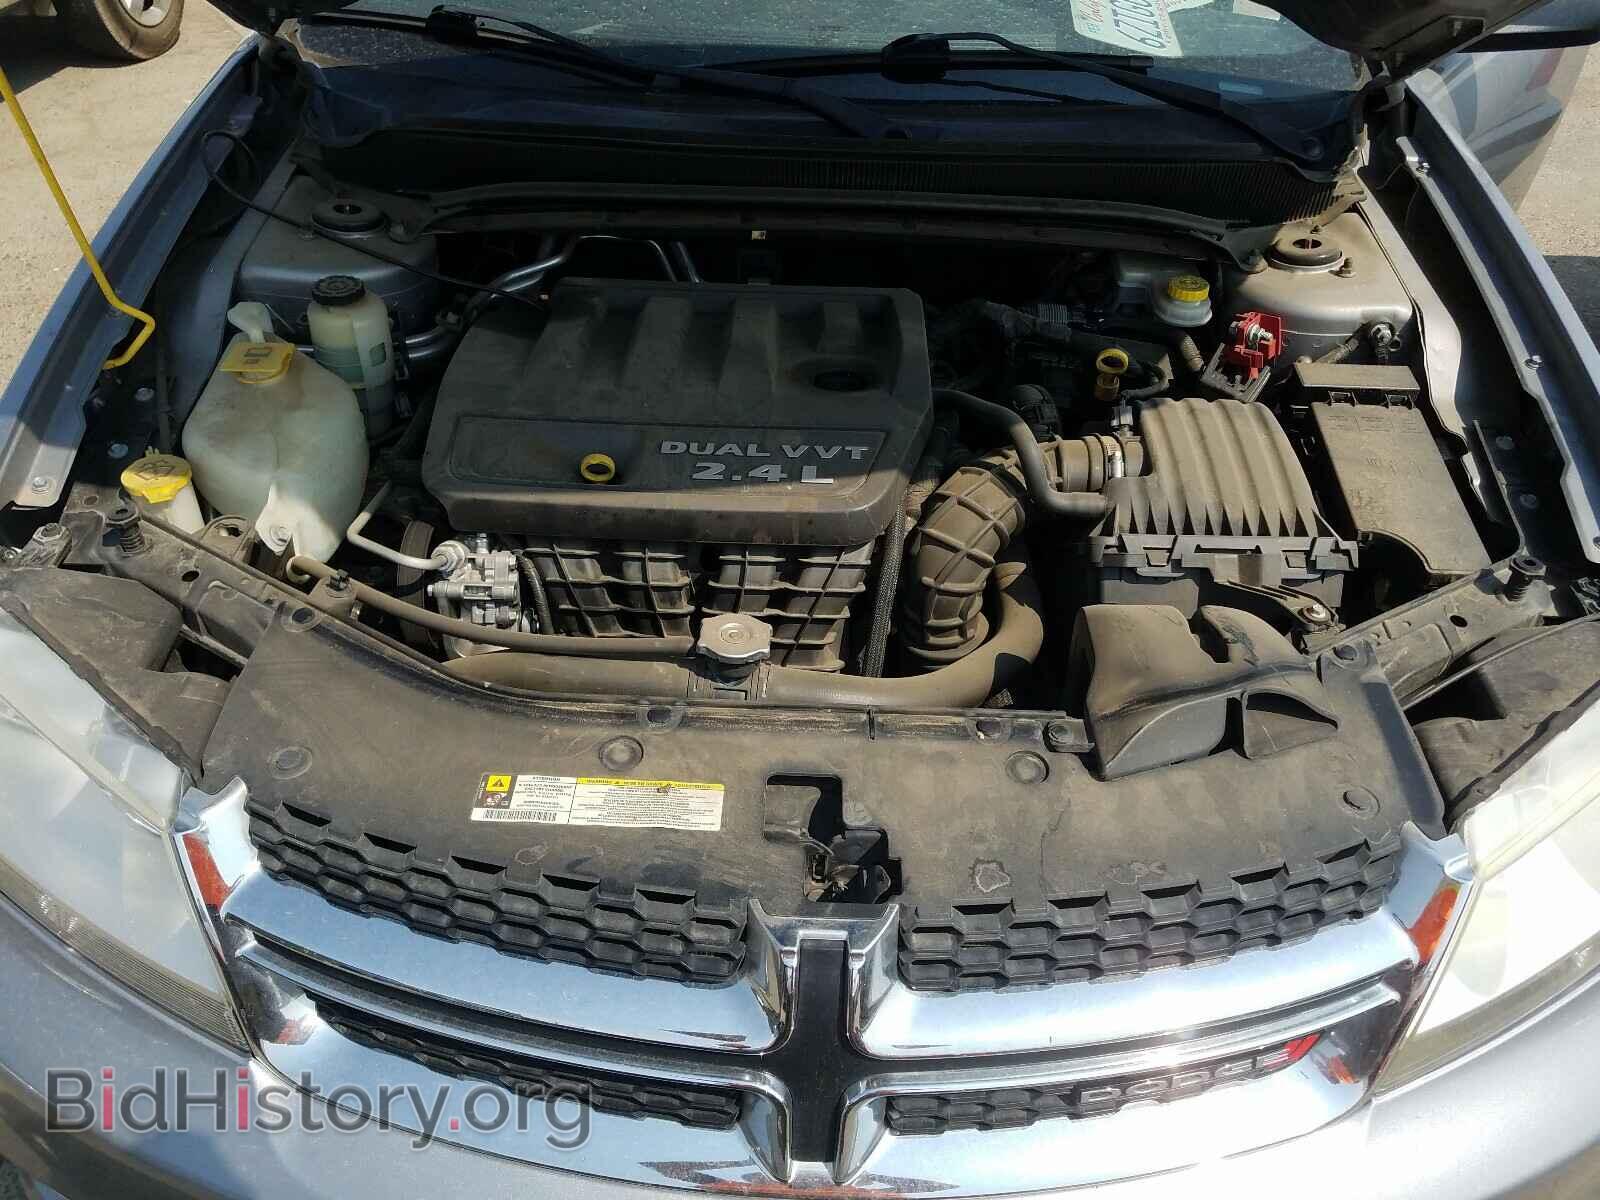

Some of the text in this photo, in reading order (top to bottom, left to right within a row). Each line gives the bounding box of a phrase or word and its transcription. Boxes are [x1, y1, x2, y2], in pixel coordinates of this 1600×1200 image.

[660, 441, 869, 460] DUAL VVT
[1080, 1048, 1290, 1104] DODGE
